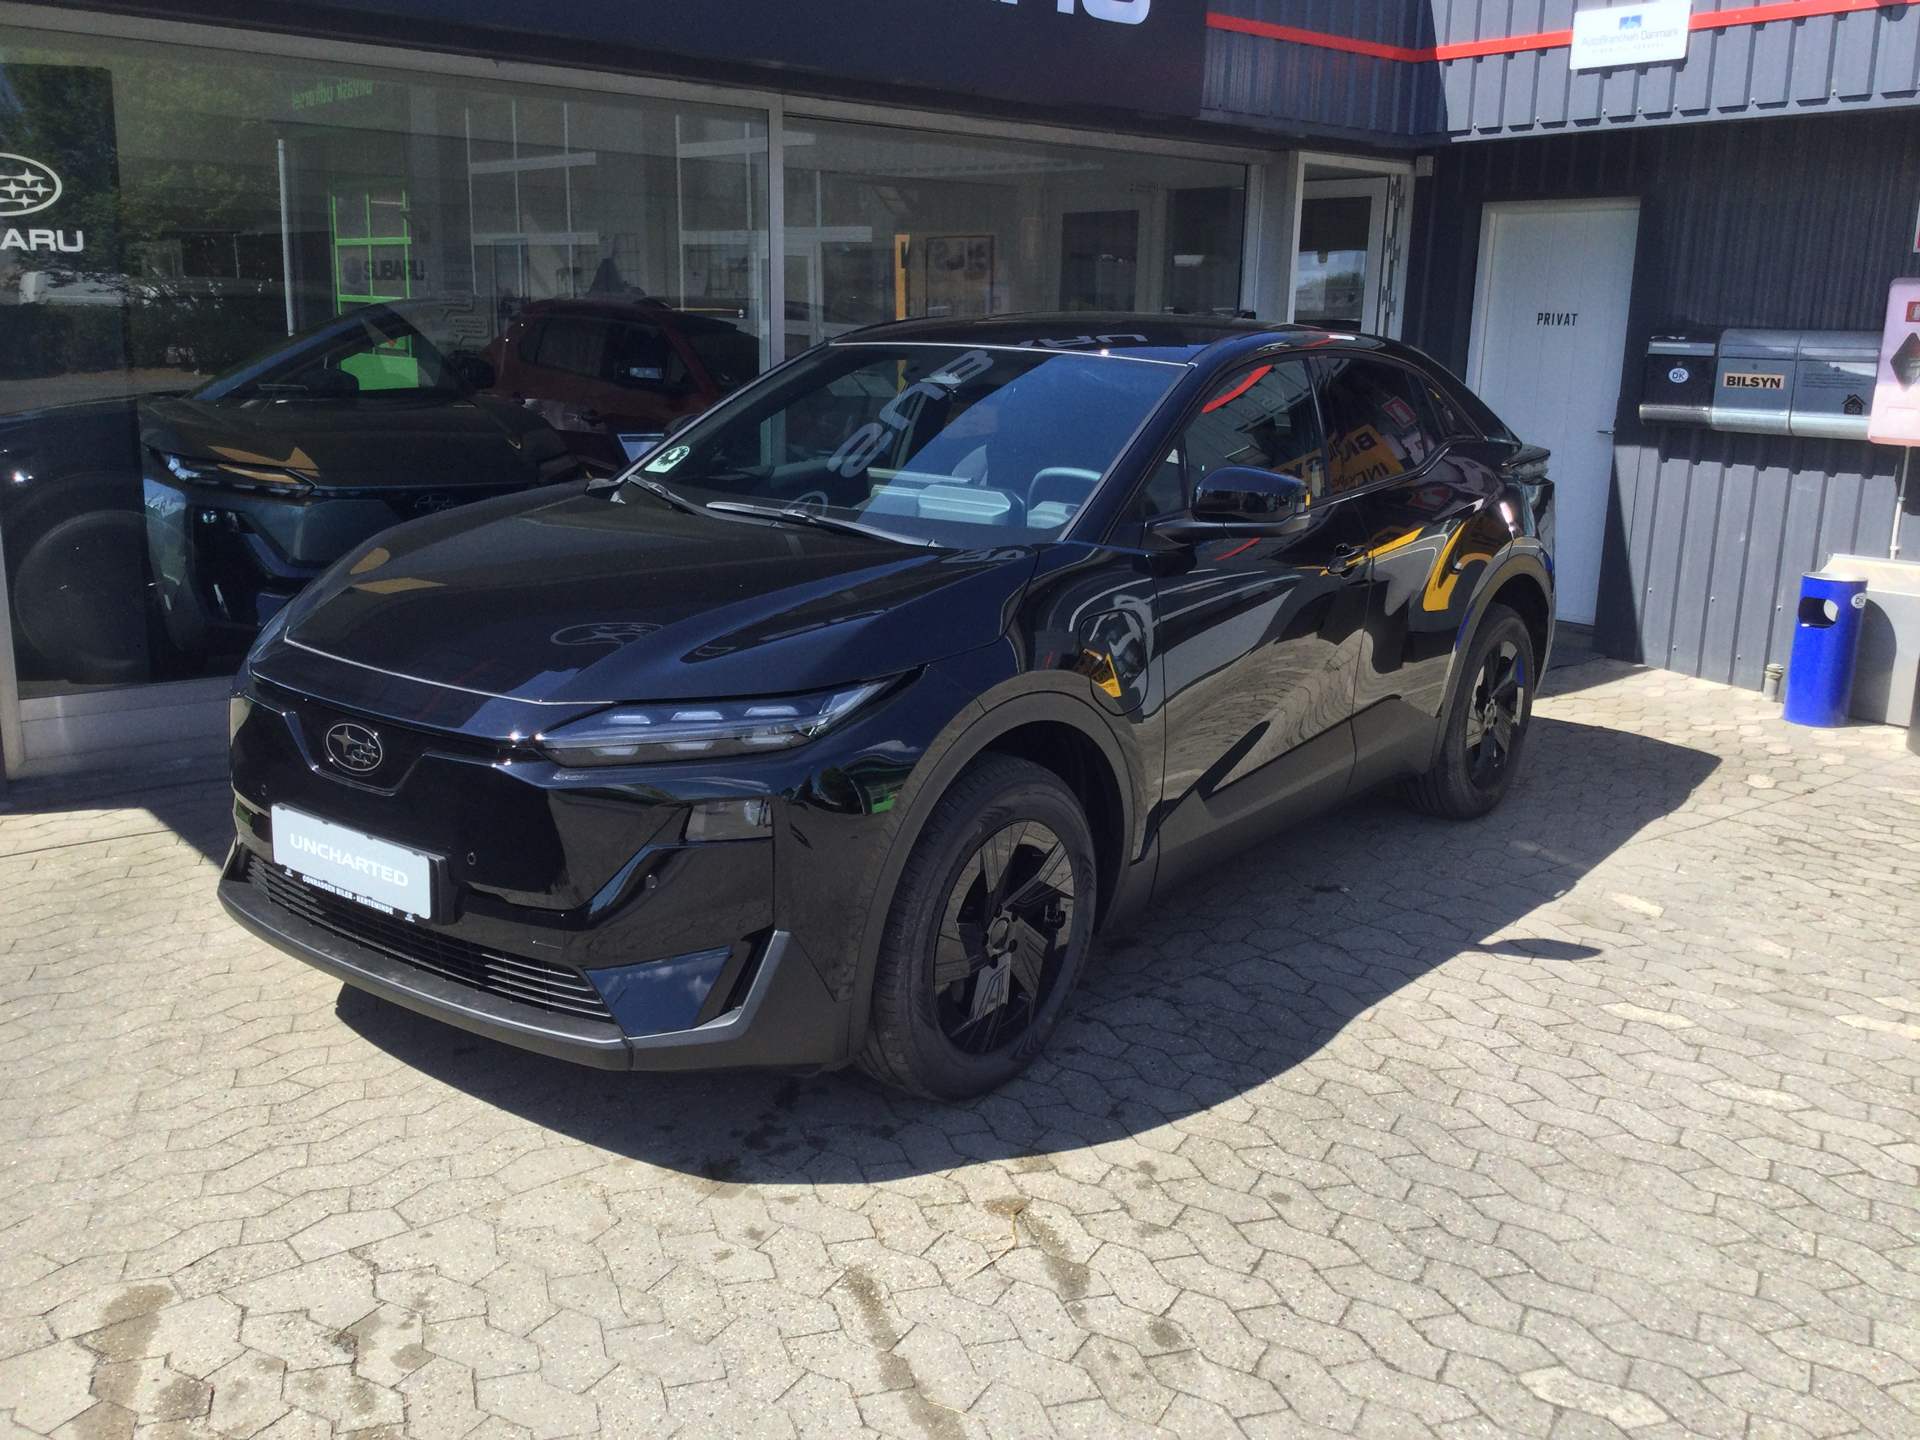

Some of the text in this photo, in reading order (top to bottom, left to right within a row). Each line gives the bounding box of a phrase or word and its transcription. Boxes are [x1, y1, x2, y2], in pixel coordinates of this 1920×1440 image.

[1581, 27, 1679, 47] AutoBranchen Danmark
[1537, 312, 1579, 326] PRIVAT
[1672, 371, 1685, 380] DK
[1726, 376, 1781, 389] BILSYN
[1847, 403, 1860, 413] 56
[290, 833, 409, 887] UNCHARTED
[302, 875, 394, 915] CONRADSEN BILER KERTEMINDE
